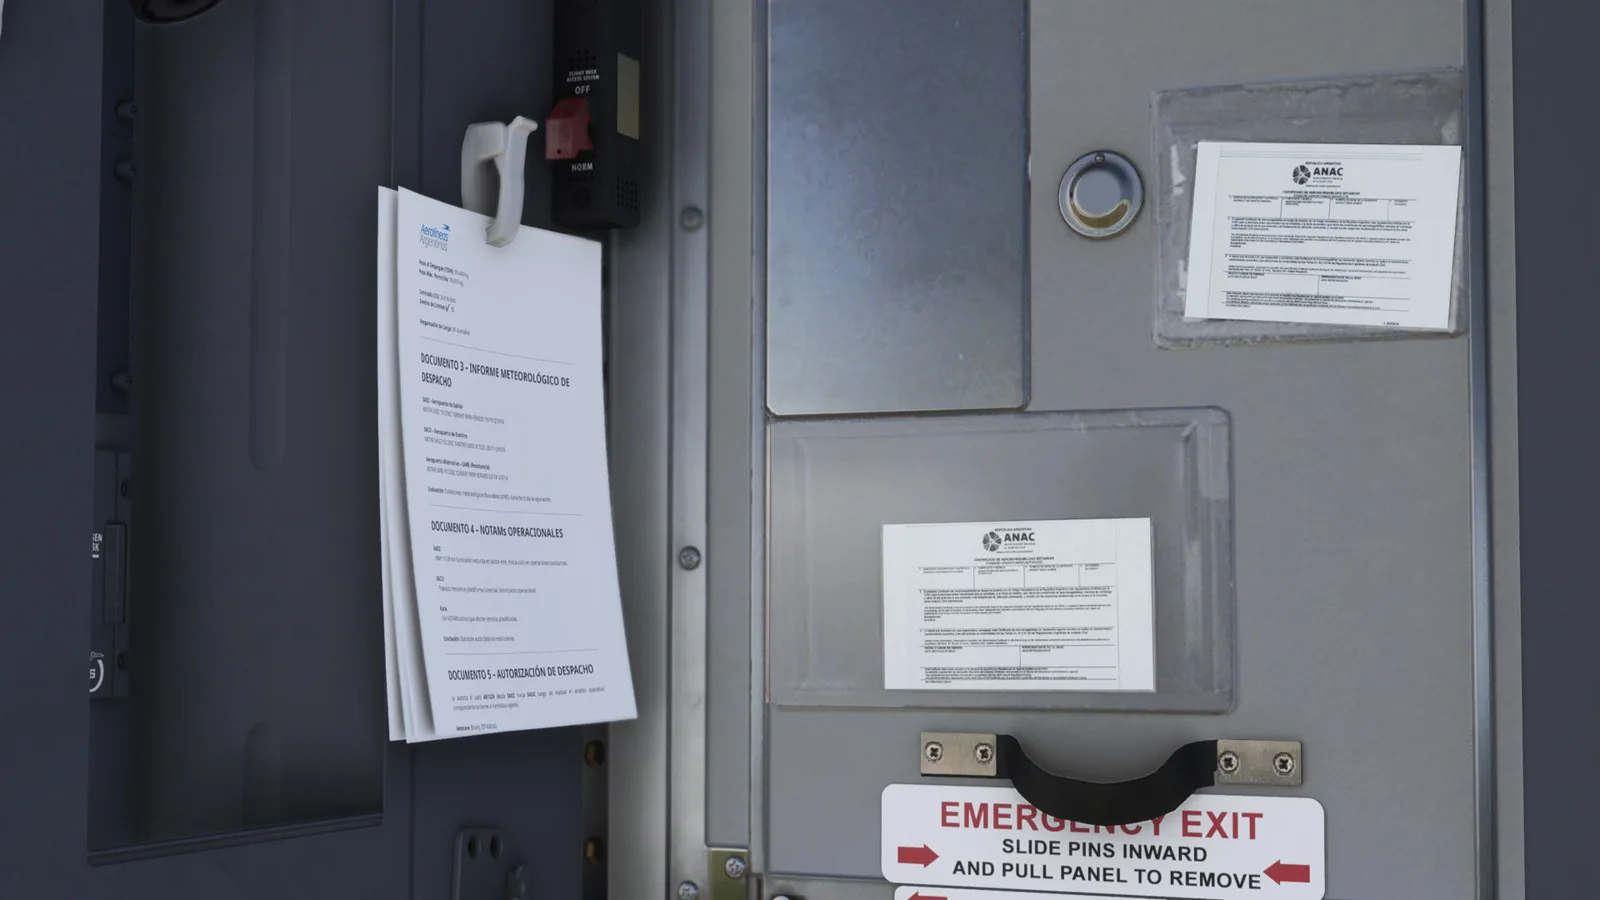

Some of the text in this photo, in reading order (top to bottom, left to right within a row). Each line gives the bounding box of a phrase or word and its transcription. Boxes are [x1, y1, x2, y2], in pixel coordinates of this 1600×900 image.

[575, 85, 591, 95] OFF
[571, 162, 593, 172] NORM
[1313, 167, 1344, 176] ANAC
[420, 352, 458, 371] DOCUMENTO
[460, 362, 464, 371] 3
[469, 363, 499, 378] INFORME
[501, 368, 559, 386] METEOROLÓGICO
[561, 377, 570, 387] DE
[422, 372, 452, 388] DESPACHO
[431, 520, 469, 534] DOCUMENTO
[470, 524, 474, 534] 4
[480, 525, 506, 536] NOTAMs
[508, 526, 564, 538] OPERACIONALES
[1004, 532, 1035, 542] ANAC
[448, 669, 486, 680] DOCUMENTO
[487, 670, 491, 679] 5
[497, 665, 546, 679] AUTORIZACIÓN
[547, 667, 556, 677] DE
[558, 664, 594, 676] DESPACHO
[1182, 810, 1263, 840] EXIT
[1002, 838, 1207, 862] SLIDE PINS INWARD
[952, 860, 1262, 890] AND PULL PANEL TO REMOVE
